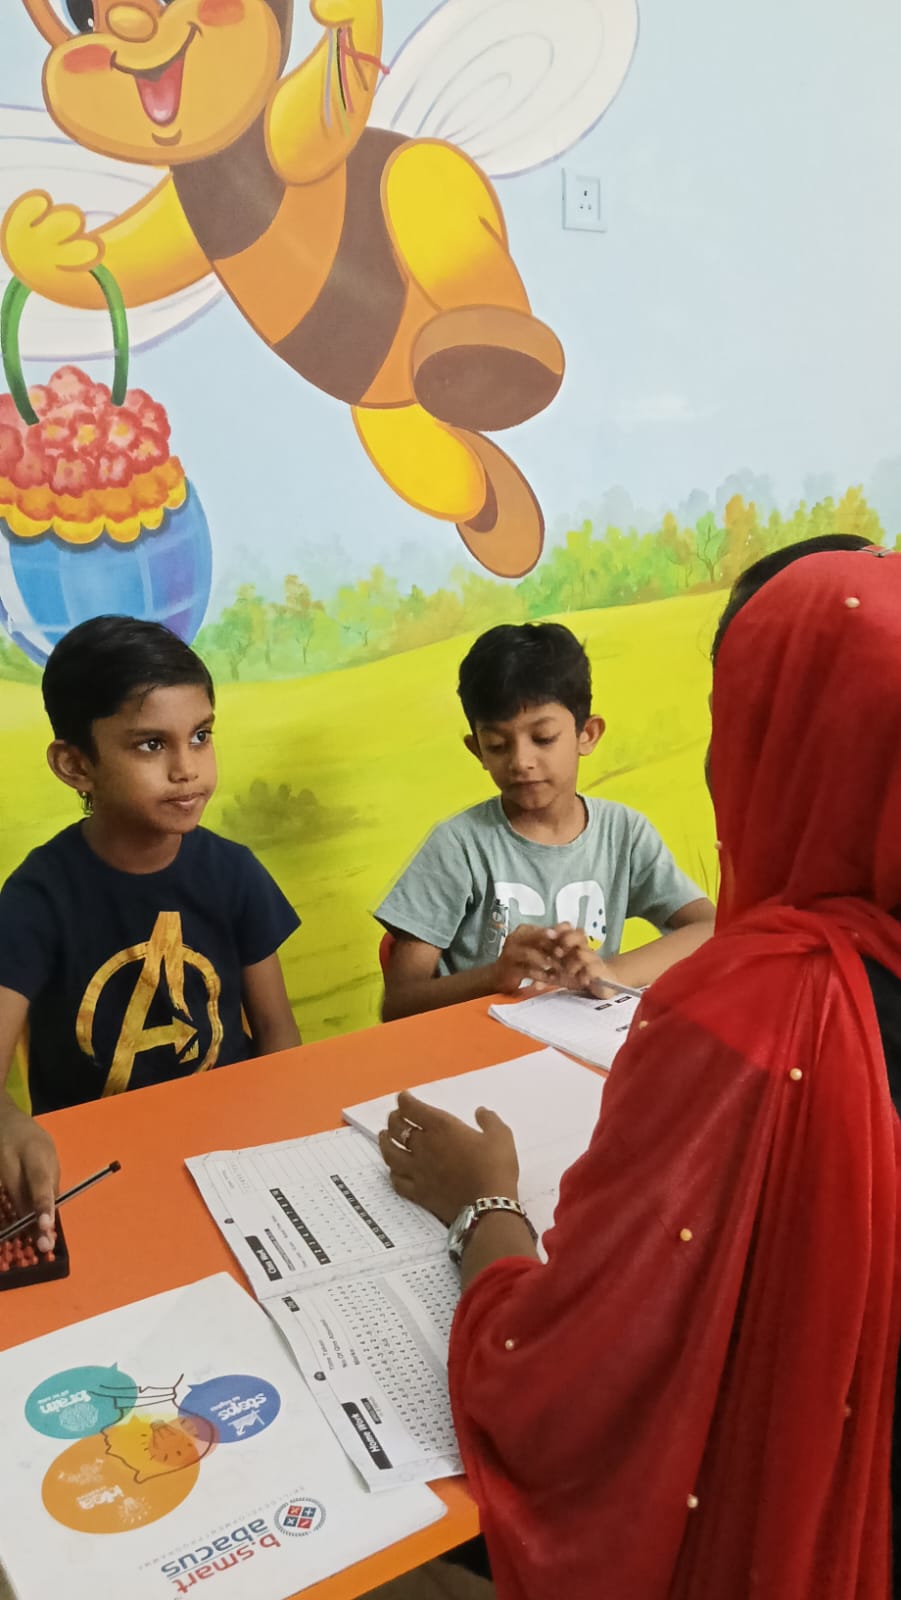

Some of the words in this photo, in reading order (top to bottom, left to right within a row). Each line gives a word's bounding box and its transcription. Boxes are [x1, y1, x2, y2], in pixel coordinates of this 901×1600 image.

[39, 1390, 91, 1414] brain
[218, 1393, 267, 1421] steps
[351, 1413, 368, 1432] Work
[363, 1431, 381, 1453] Home
[160, 1518, 267, 1576] abacus
[171, 1532, 281, 1594] b.smart
